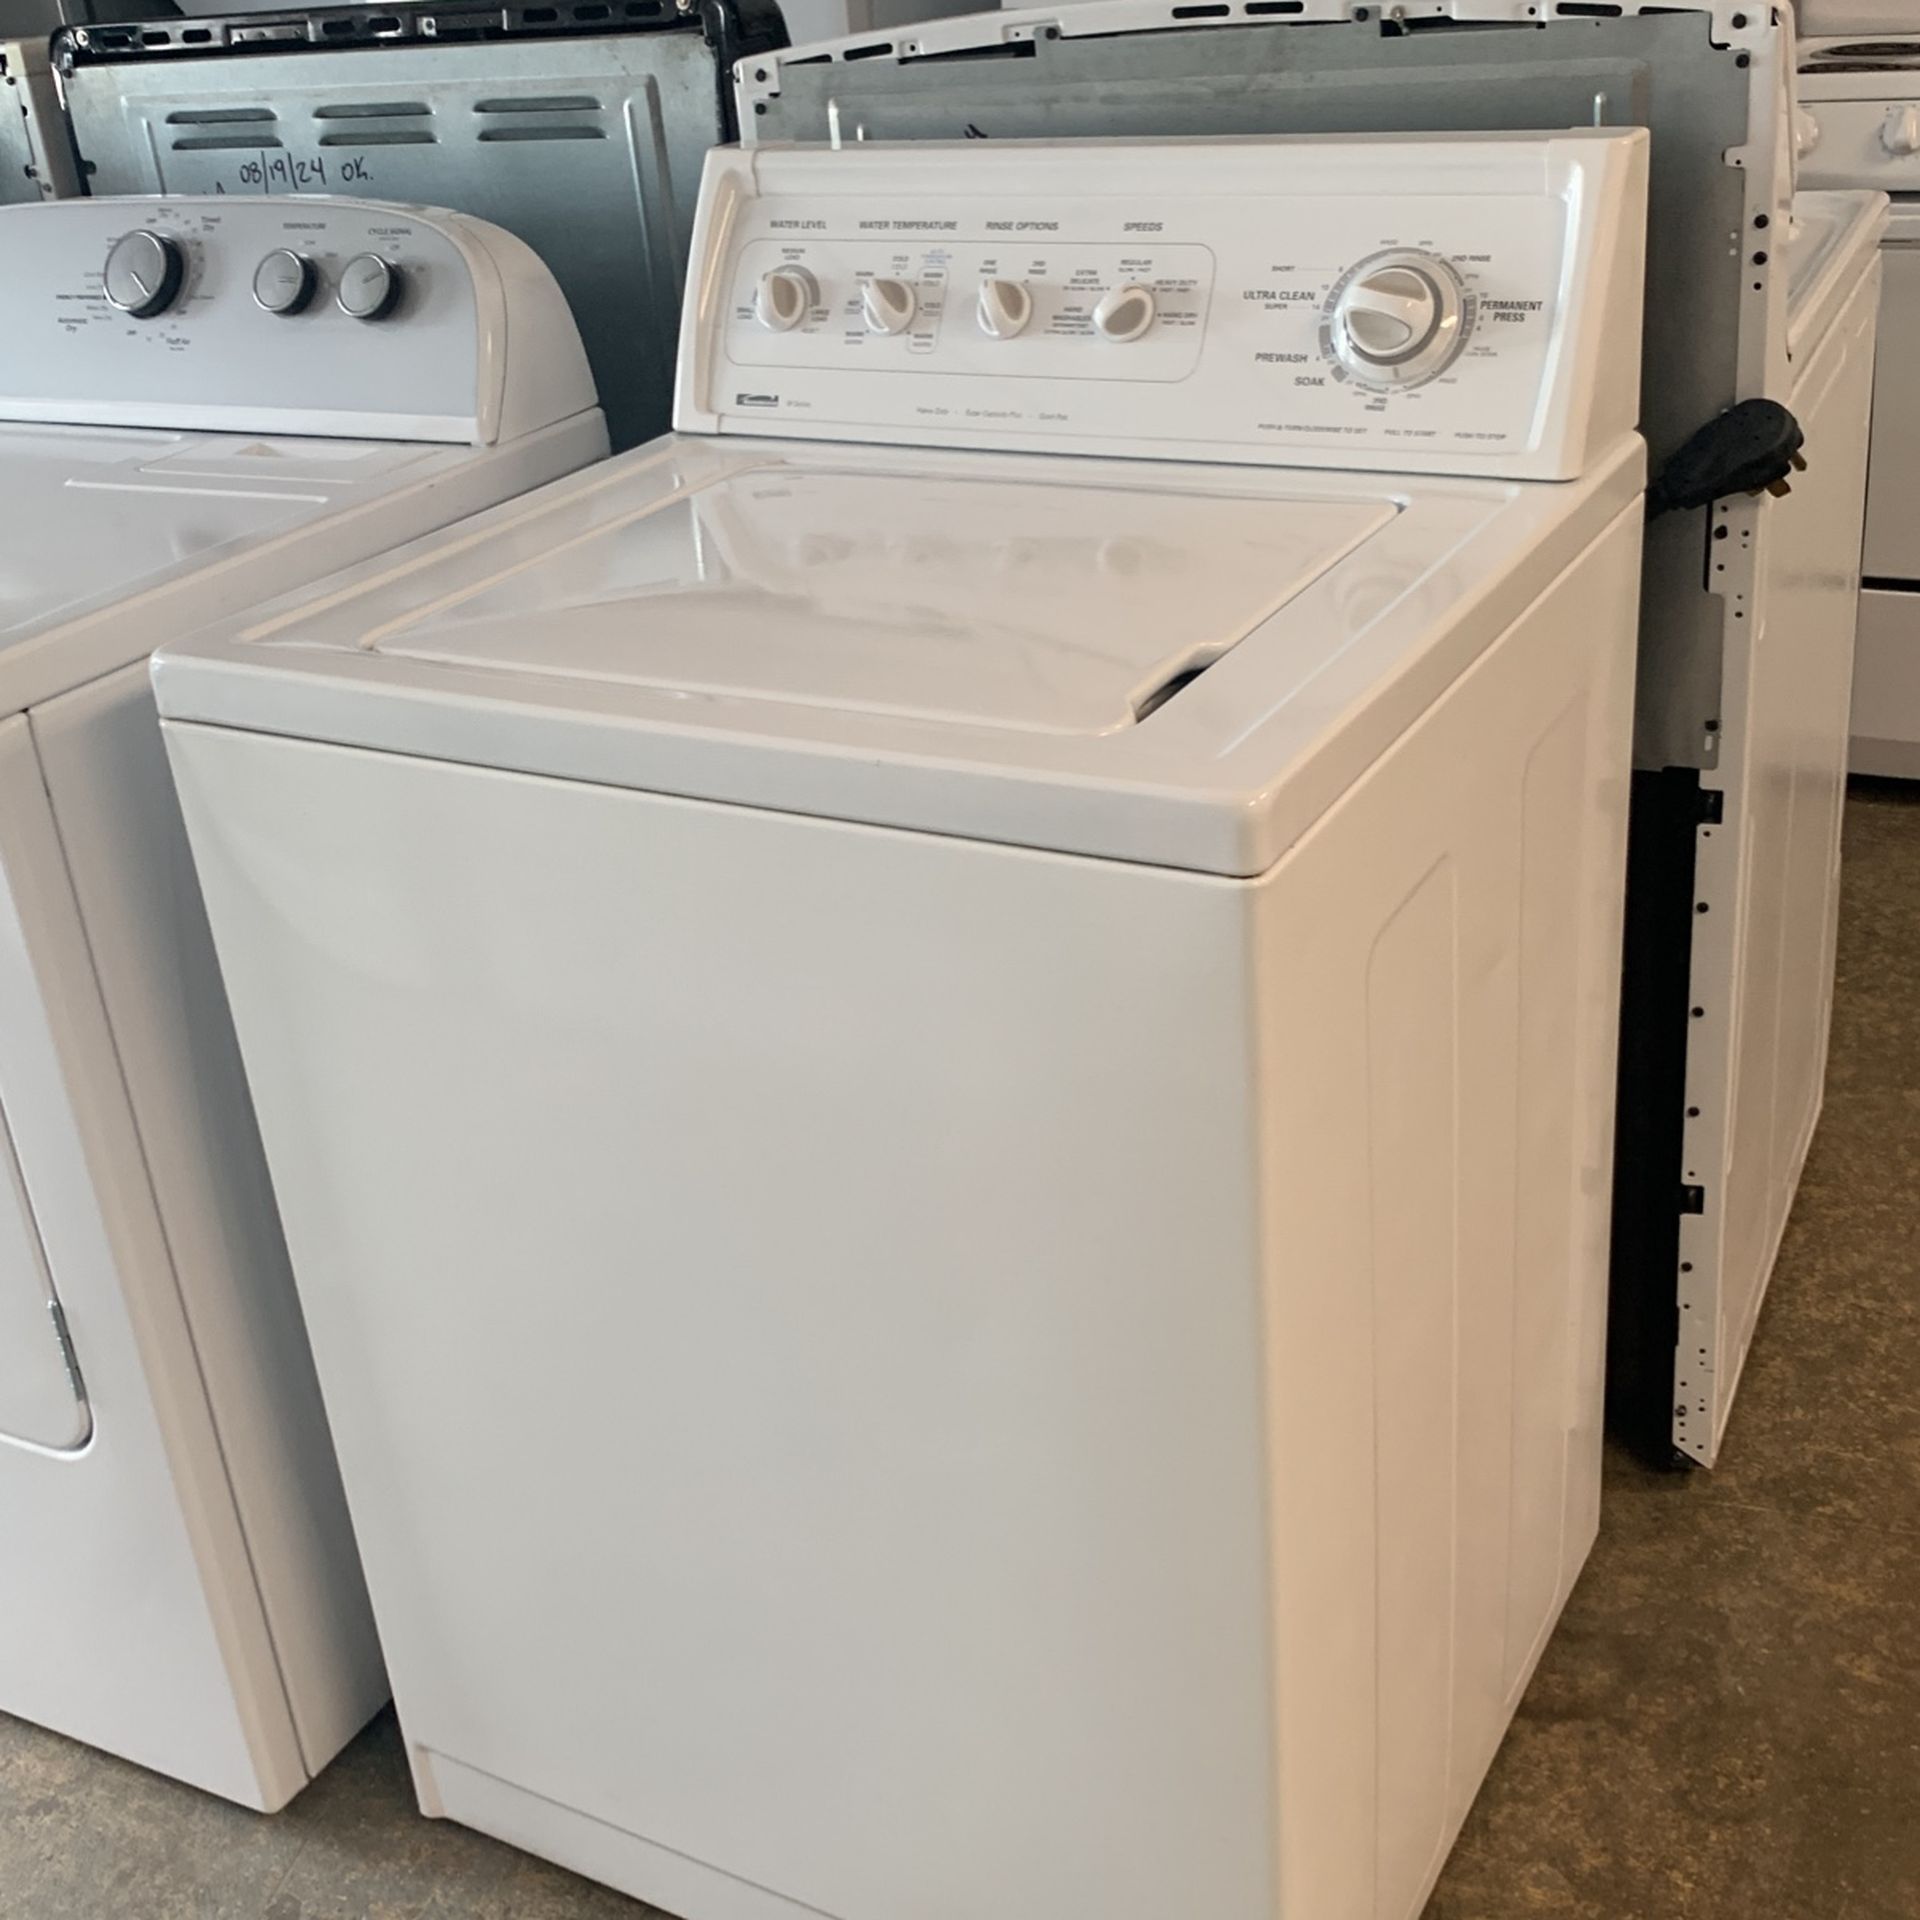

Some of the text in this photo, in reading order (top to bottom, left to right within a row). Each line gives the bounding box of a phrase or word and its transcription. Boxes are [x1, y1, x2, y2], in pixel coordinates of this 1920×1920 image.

[239, 151, 326, 194] 08/19/24
[770, 221, 827, 230] WATER LEVEL
[859, 221, 958, 231] WATER TEMPERATURE
[985, 221, 1059, 231] RINSE OPTIONS
[1123, 222, 1163, 232] SPEEDS
[1243, 291, 1315, 301] ULTRA CLEAN
[1480, 301, 1543, 311] PERMANENT
[1493, 312, 1526, 322] PRESS
[1254, 353, 1308, 363] PREWASH
[1294, 376, 1326, 386] SOAK
